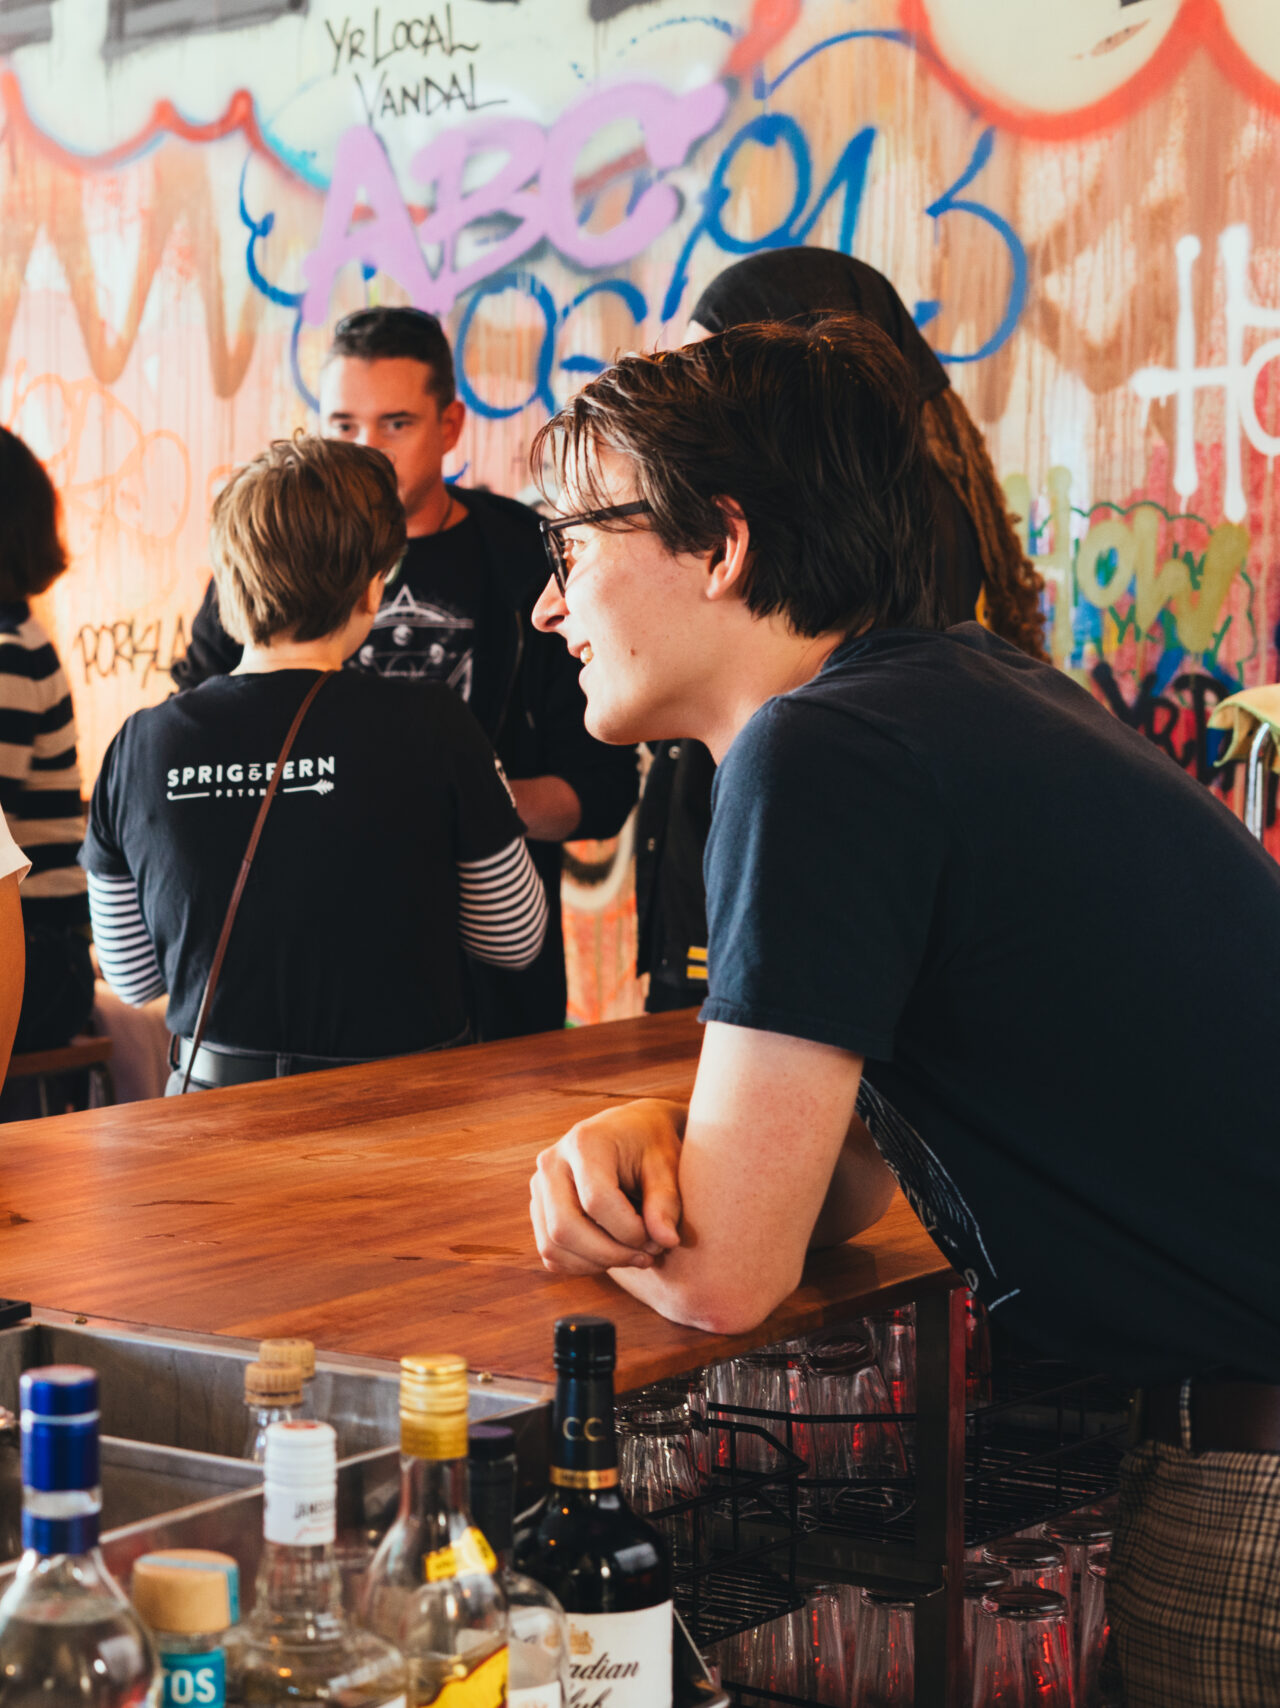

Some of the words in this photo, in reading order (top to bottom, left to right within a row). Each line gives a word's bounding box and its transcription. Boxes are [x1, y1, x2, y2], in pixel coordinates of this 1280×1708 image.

[371, 2, 481, 69] LOCAL
[353, 61, 509, 130] VANDAL
[300, 78, 730, 329] ABC
[215, 787, 278, 798] PETON
[562, 1416, 604, 1442] CC
[568, 1651, 640, 1680] adian
